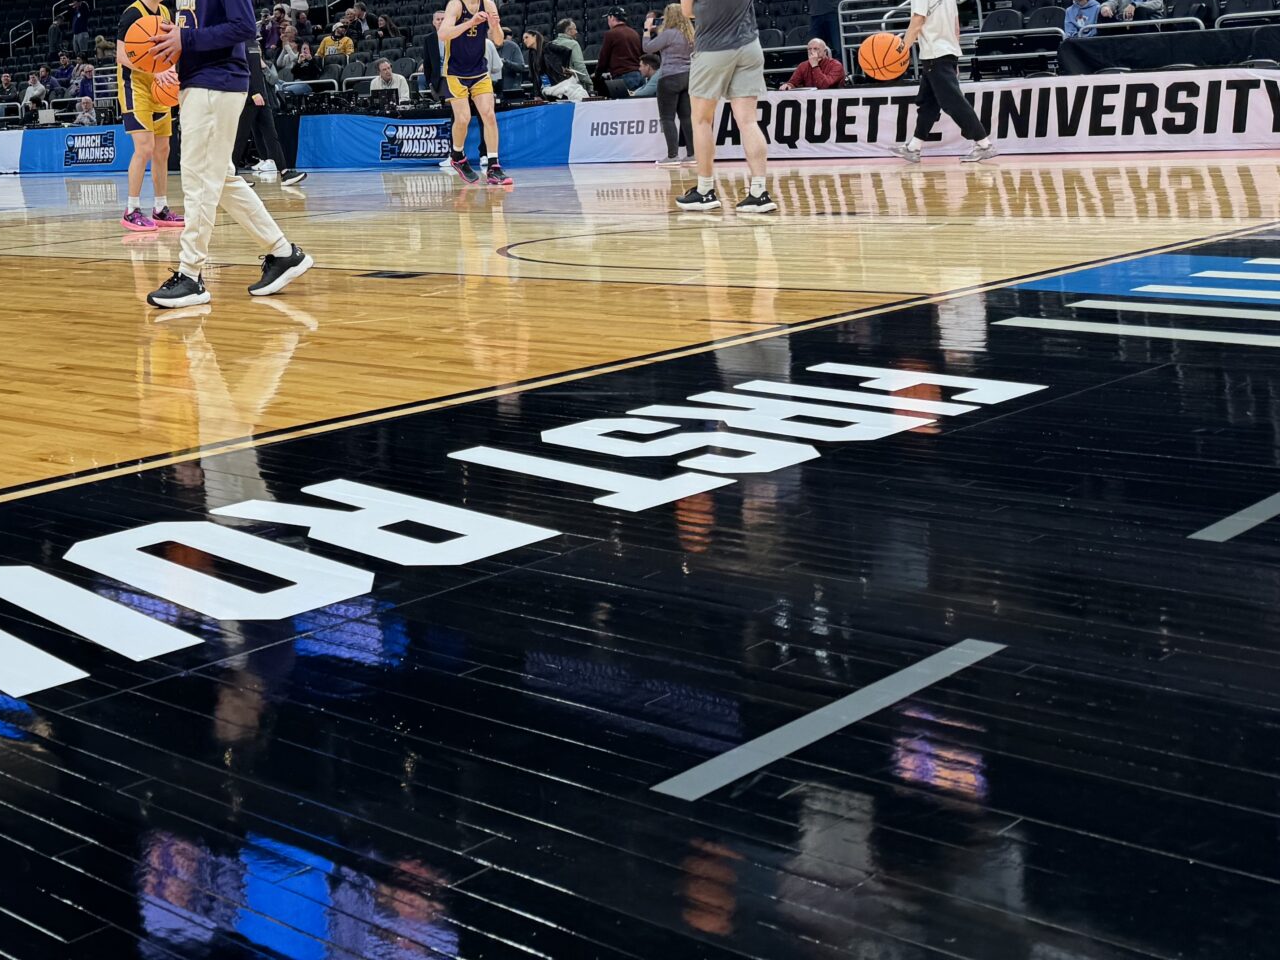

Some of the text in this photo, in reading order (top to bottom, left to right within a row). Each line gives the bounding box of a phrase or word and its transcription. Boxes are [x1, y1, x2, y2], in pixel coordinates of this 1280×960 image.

[715, 92, 943, 148] ARQUETT
[396, 126, 437, 139] MARCH
[590, 120, 645, 137] HOSTED
[74, 134, 101, 148] MARCH
[78, 147, 114, 160] MADNESS
[449, 362, 1046, 512] FIRST
